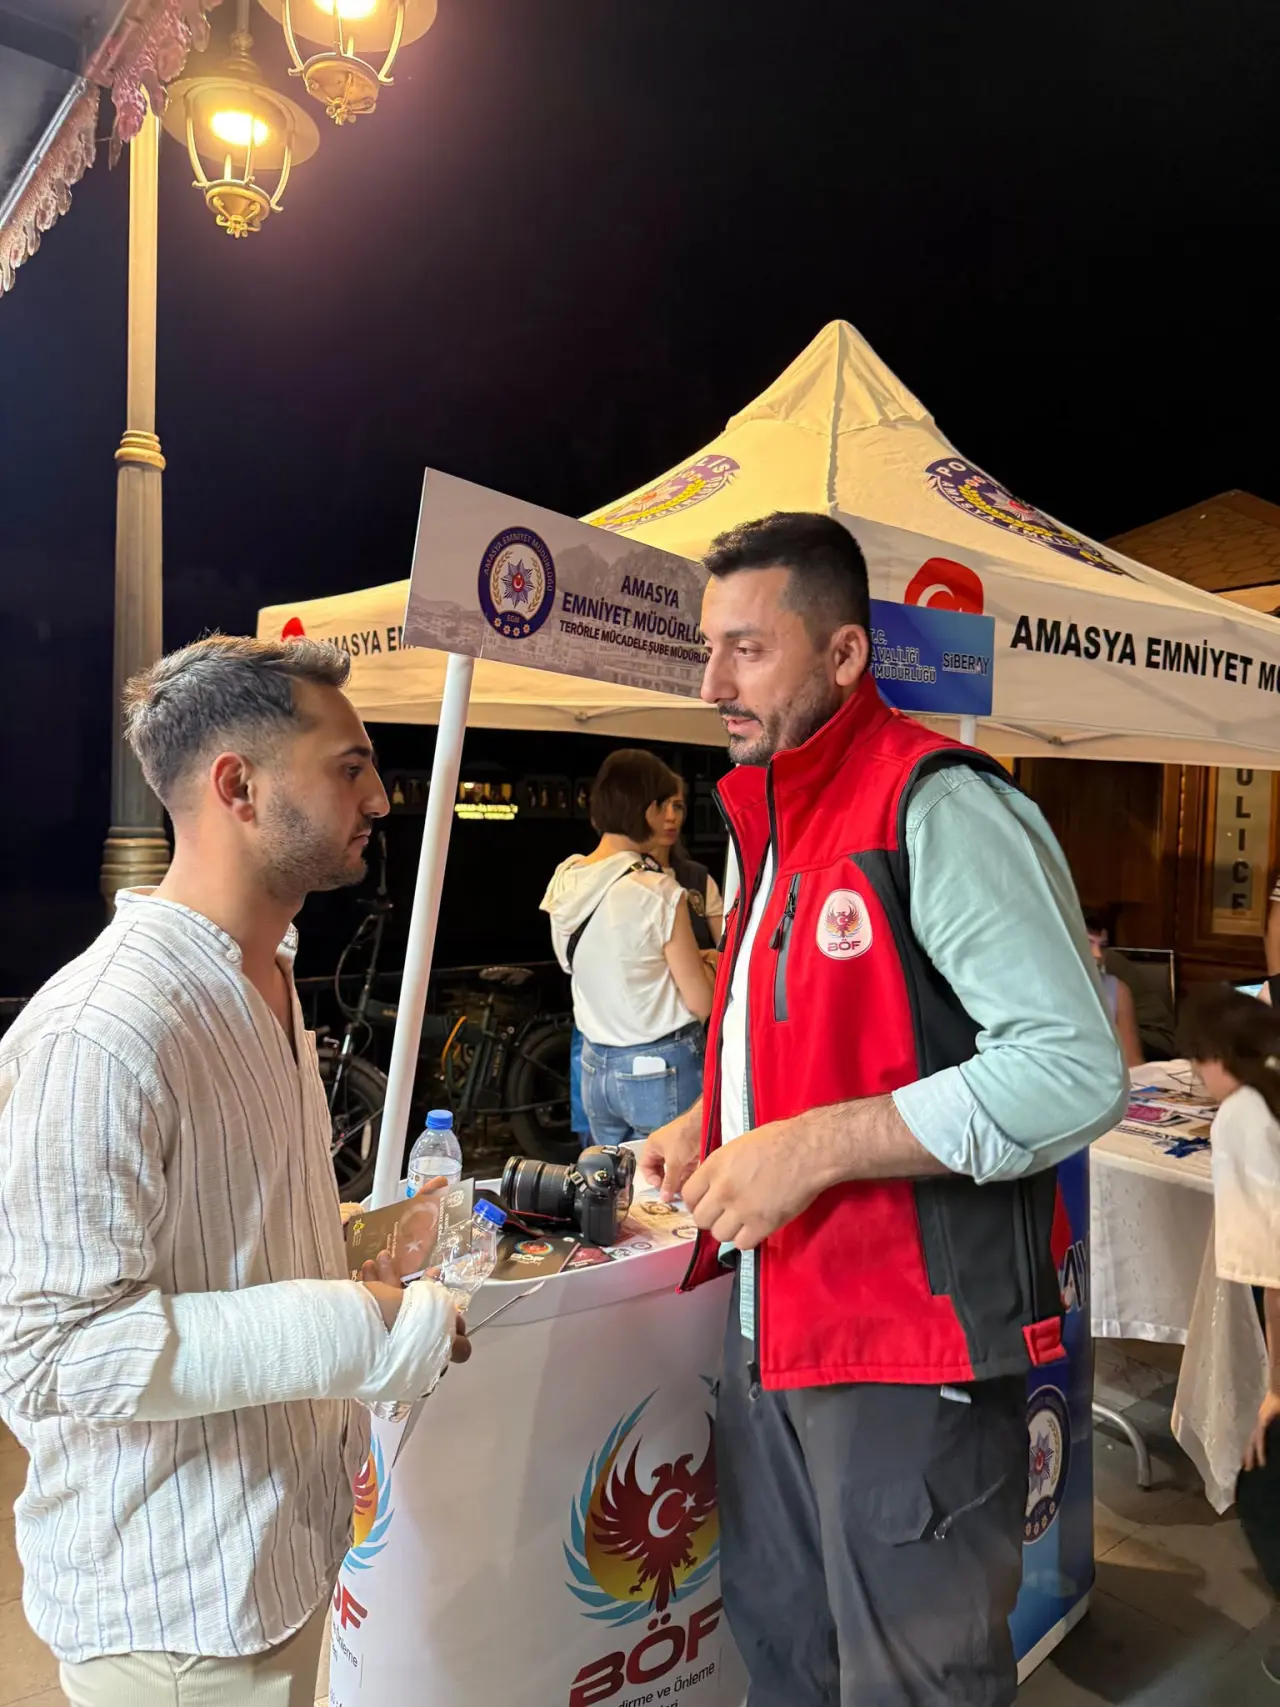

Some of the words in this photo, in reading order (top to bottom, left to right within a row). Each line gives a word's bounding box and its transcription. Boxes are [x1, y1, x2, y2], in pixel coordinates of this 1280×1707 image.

[621, 575, 680, 609] AMASYA
[562, 592, 632, 627] EMNİYET
[632, 610, 705, 645] MÜDÜRLÜ
[559, 620, 600, 640] TERÖRLE
[600, 630, 649, 651] MÜCADELE
[648, 641, 670, 657] ŞUBE
[670, 646, 710, 665] MÜDÜRLÜ
[1010, 614, 1137, 666] AMASYA
[1145, 637, 1253, 685] EMNİYET
[875, 662, 937, 684] MÜDÜRLÜĞÜ
[569, 1597, 724, 1707] BÖF
[656, 1687, 671, 1700] ve
[674, 1661, 715, 1692] Önleme
